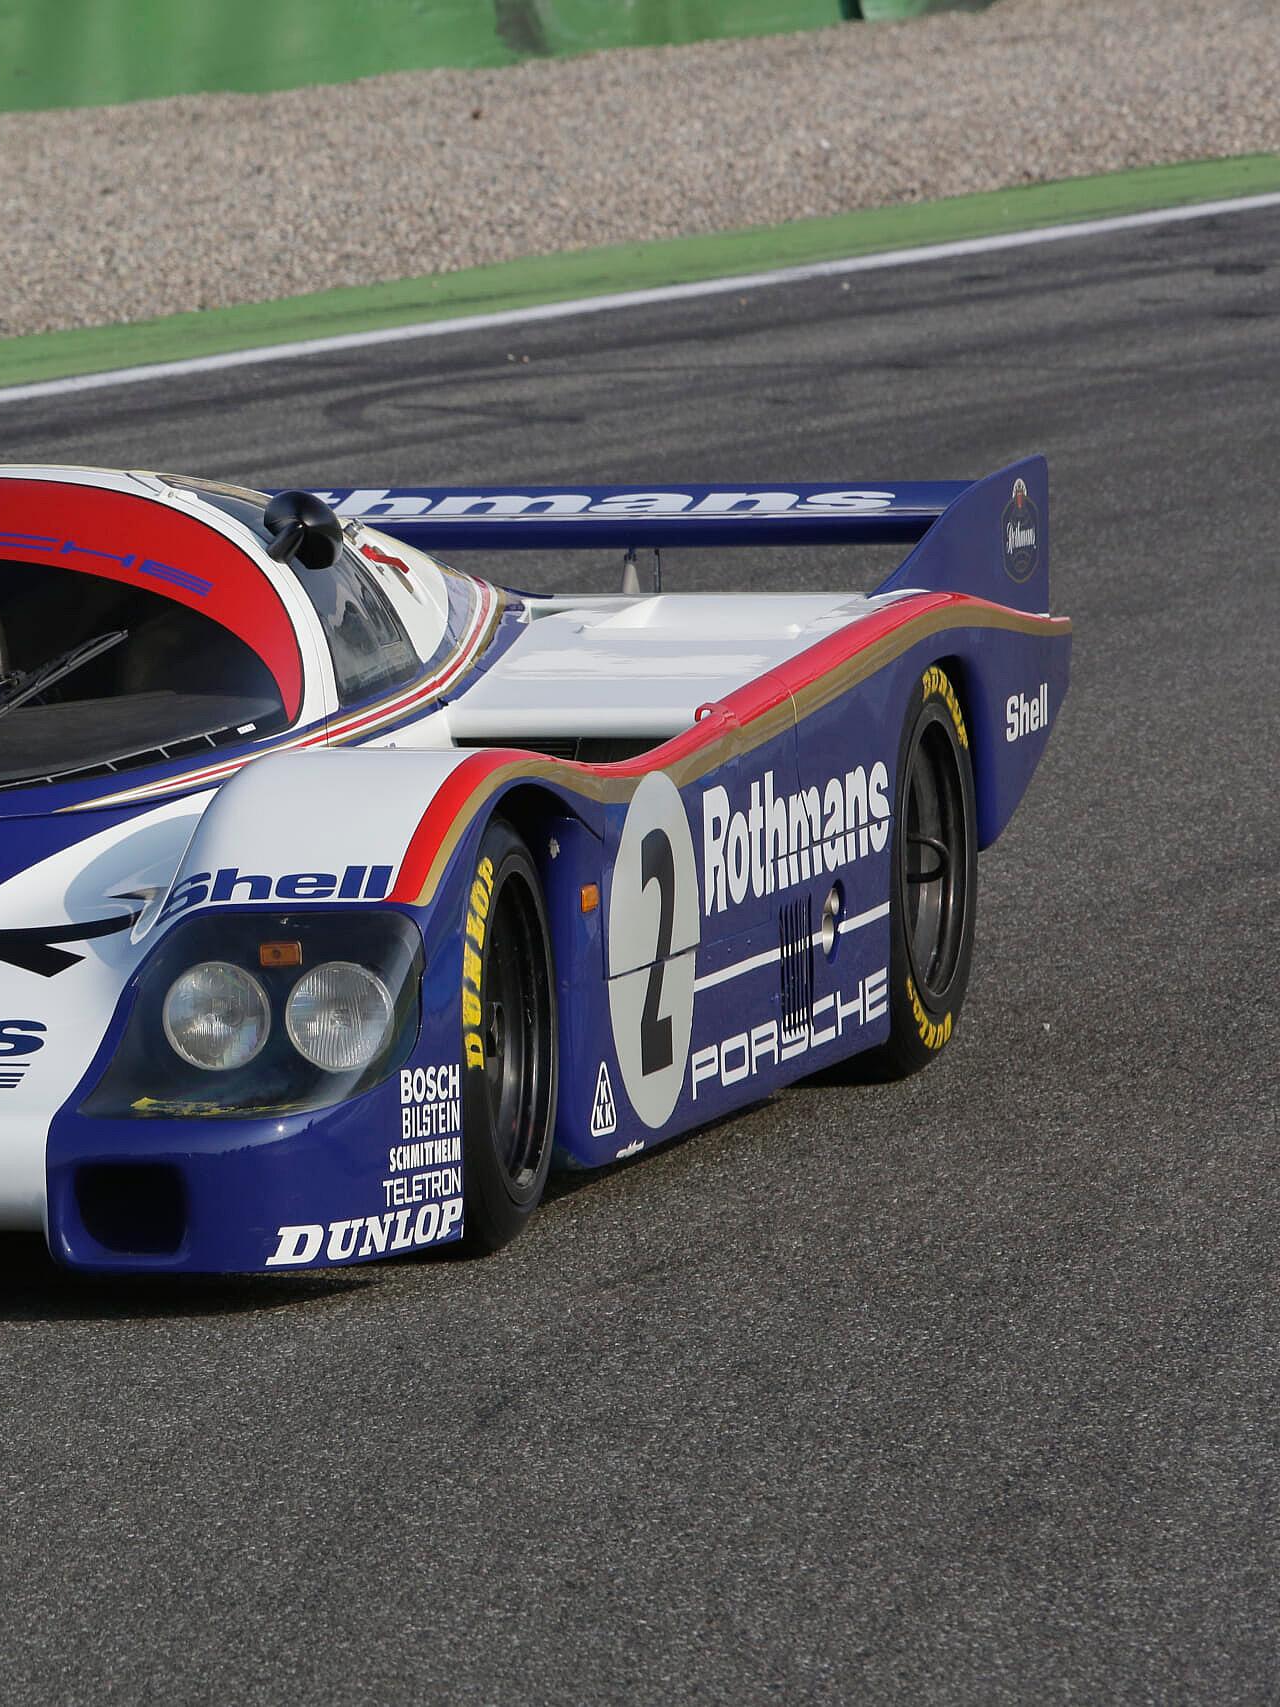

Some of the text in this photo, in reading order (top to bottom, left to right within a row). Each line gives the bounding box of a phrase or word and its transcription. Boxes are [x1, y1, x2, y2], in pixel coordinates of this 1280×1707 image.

[312, 487, 896, 516] hmans
[1006, 683, 1048, 742] Shell
[703, 761, 890, 916] Rothmans
[155, 865, 394, 926] Shell
[462, 857, 494, 1070] DUNLOP
[641, 828, 676, 1077] 2
[691, 966, 888, 1101] PORSCHE
[400, 1064, 460, 1105] BOSCH
[402, 1100, 461, 1140] BILSTEIN
[389, 1137, 462, 1173] SCHMITTHELM
[383, 1166, 462, 1207] TELETRON
[265, 1197, 464, 1266] DUNLOP
